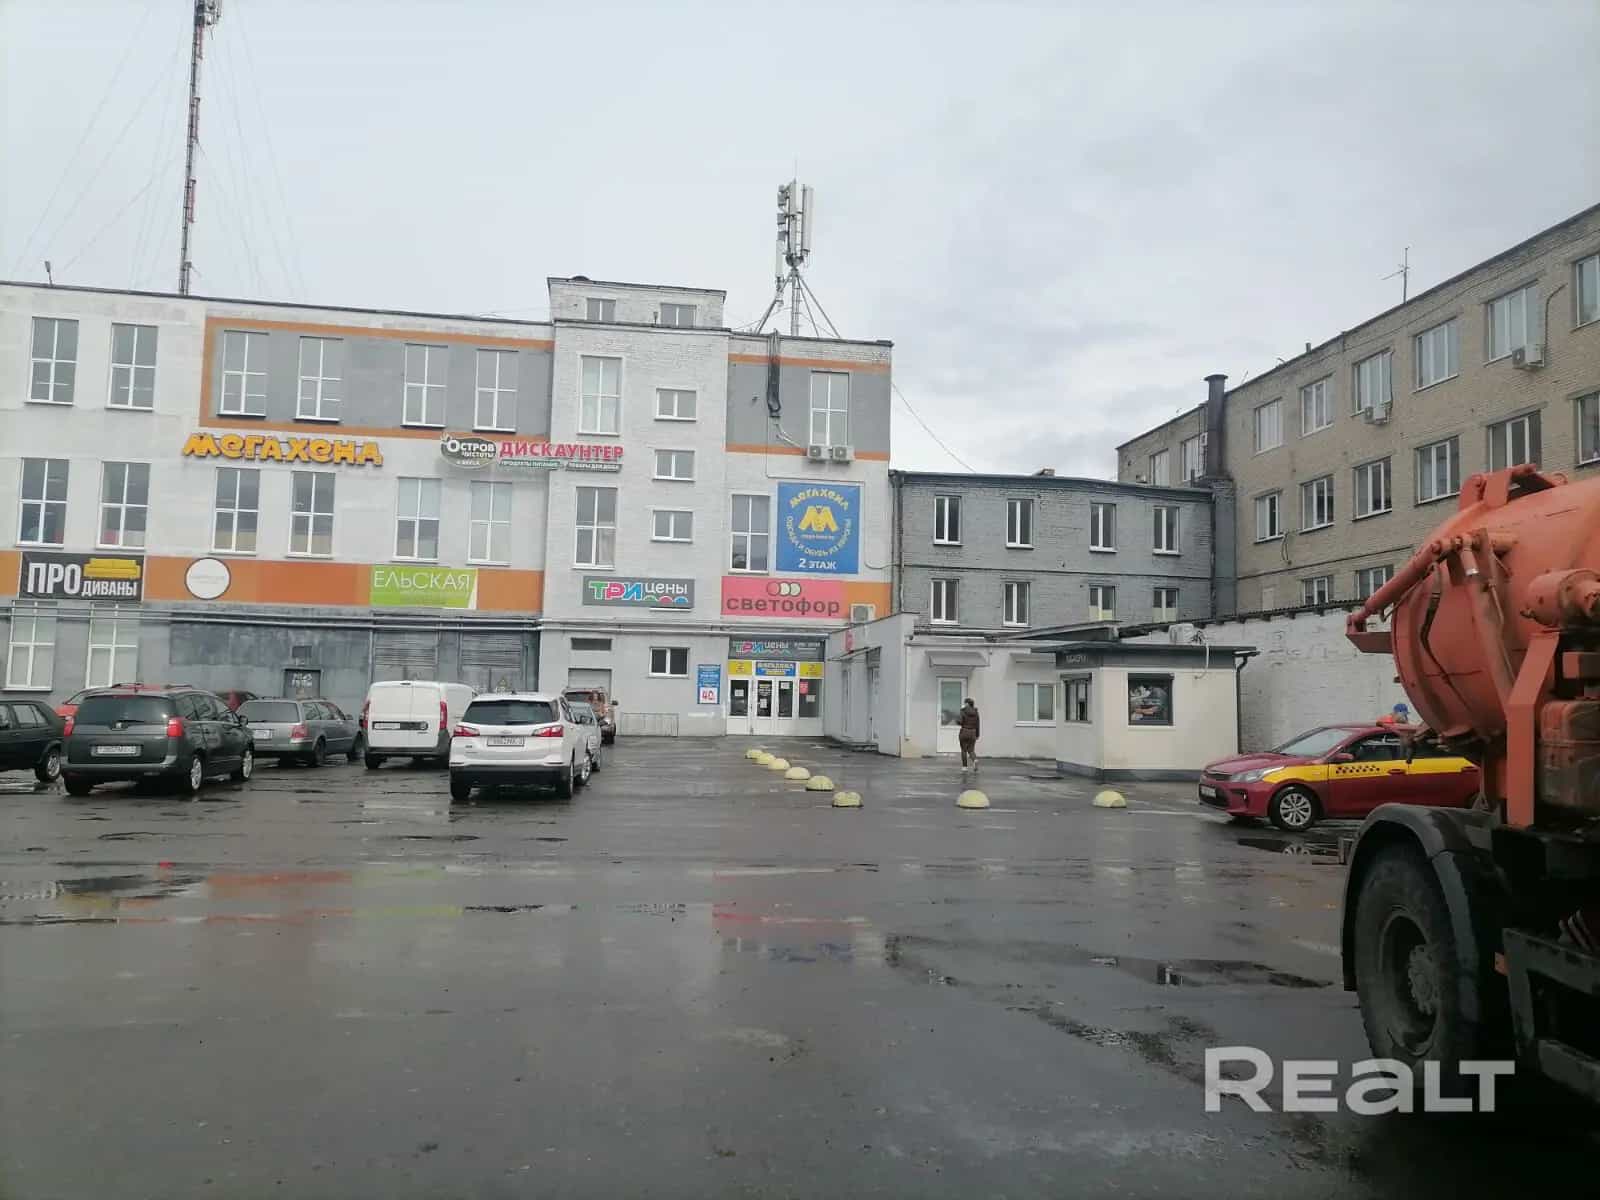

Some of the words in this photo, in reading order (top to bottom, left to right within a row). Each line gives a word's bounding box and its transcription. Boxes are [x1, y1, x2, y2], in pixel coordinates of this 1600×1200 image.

[446, 439, 496, 453] ОСТРОВ
[500, 441, 624, 460] ДИСКАУНТЕР
[798, 558, 807, 569] 2
[808, 560, 837, 570] ЭТАЖ
[27, 562, 82, 595] ПРО
[81, 580, 138, 597] ДИВАНЫ
[374, 571, 470, 590] ЕЛЬСКАЯ
[588, 580, 644, 601] ТРИ
[645, 582, 688, 595] цены
[726, 597, 840, 617] светофор
